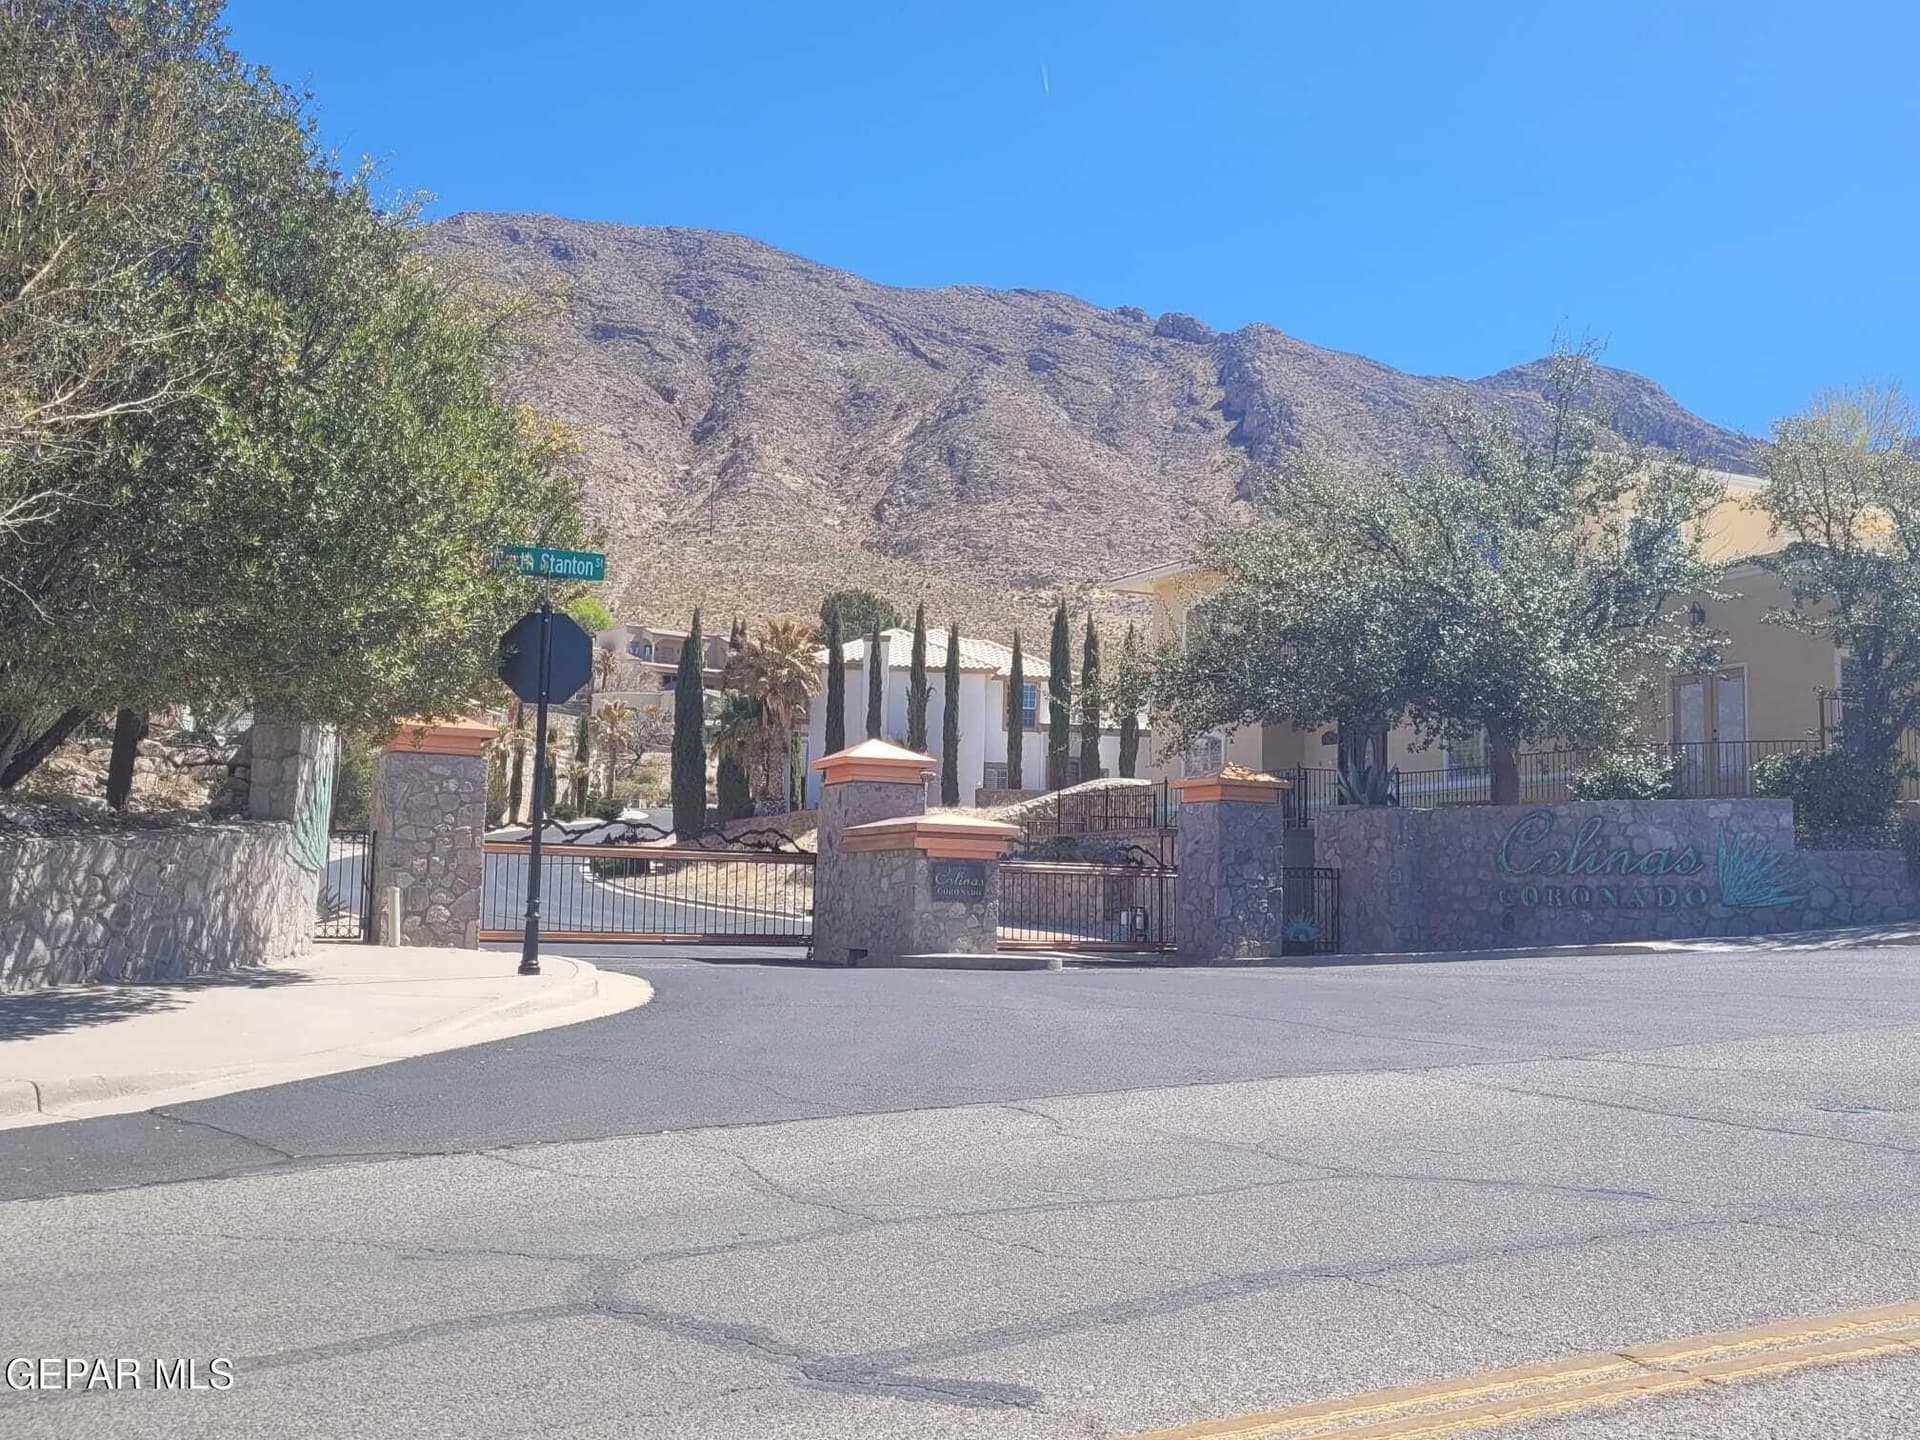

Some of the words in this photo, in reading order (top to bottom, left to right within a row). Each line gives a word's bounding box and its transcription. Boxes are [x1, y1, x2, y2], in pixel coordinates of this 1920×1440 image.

[541, 553, 594, 576] Stanton
[1496, 809, 1704, 876] Colinas
[1499, 886, 1708, 907] CORONADO
